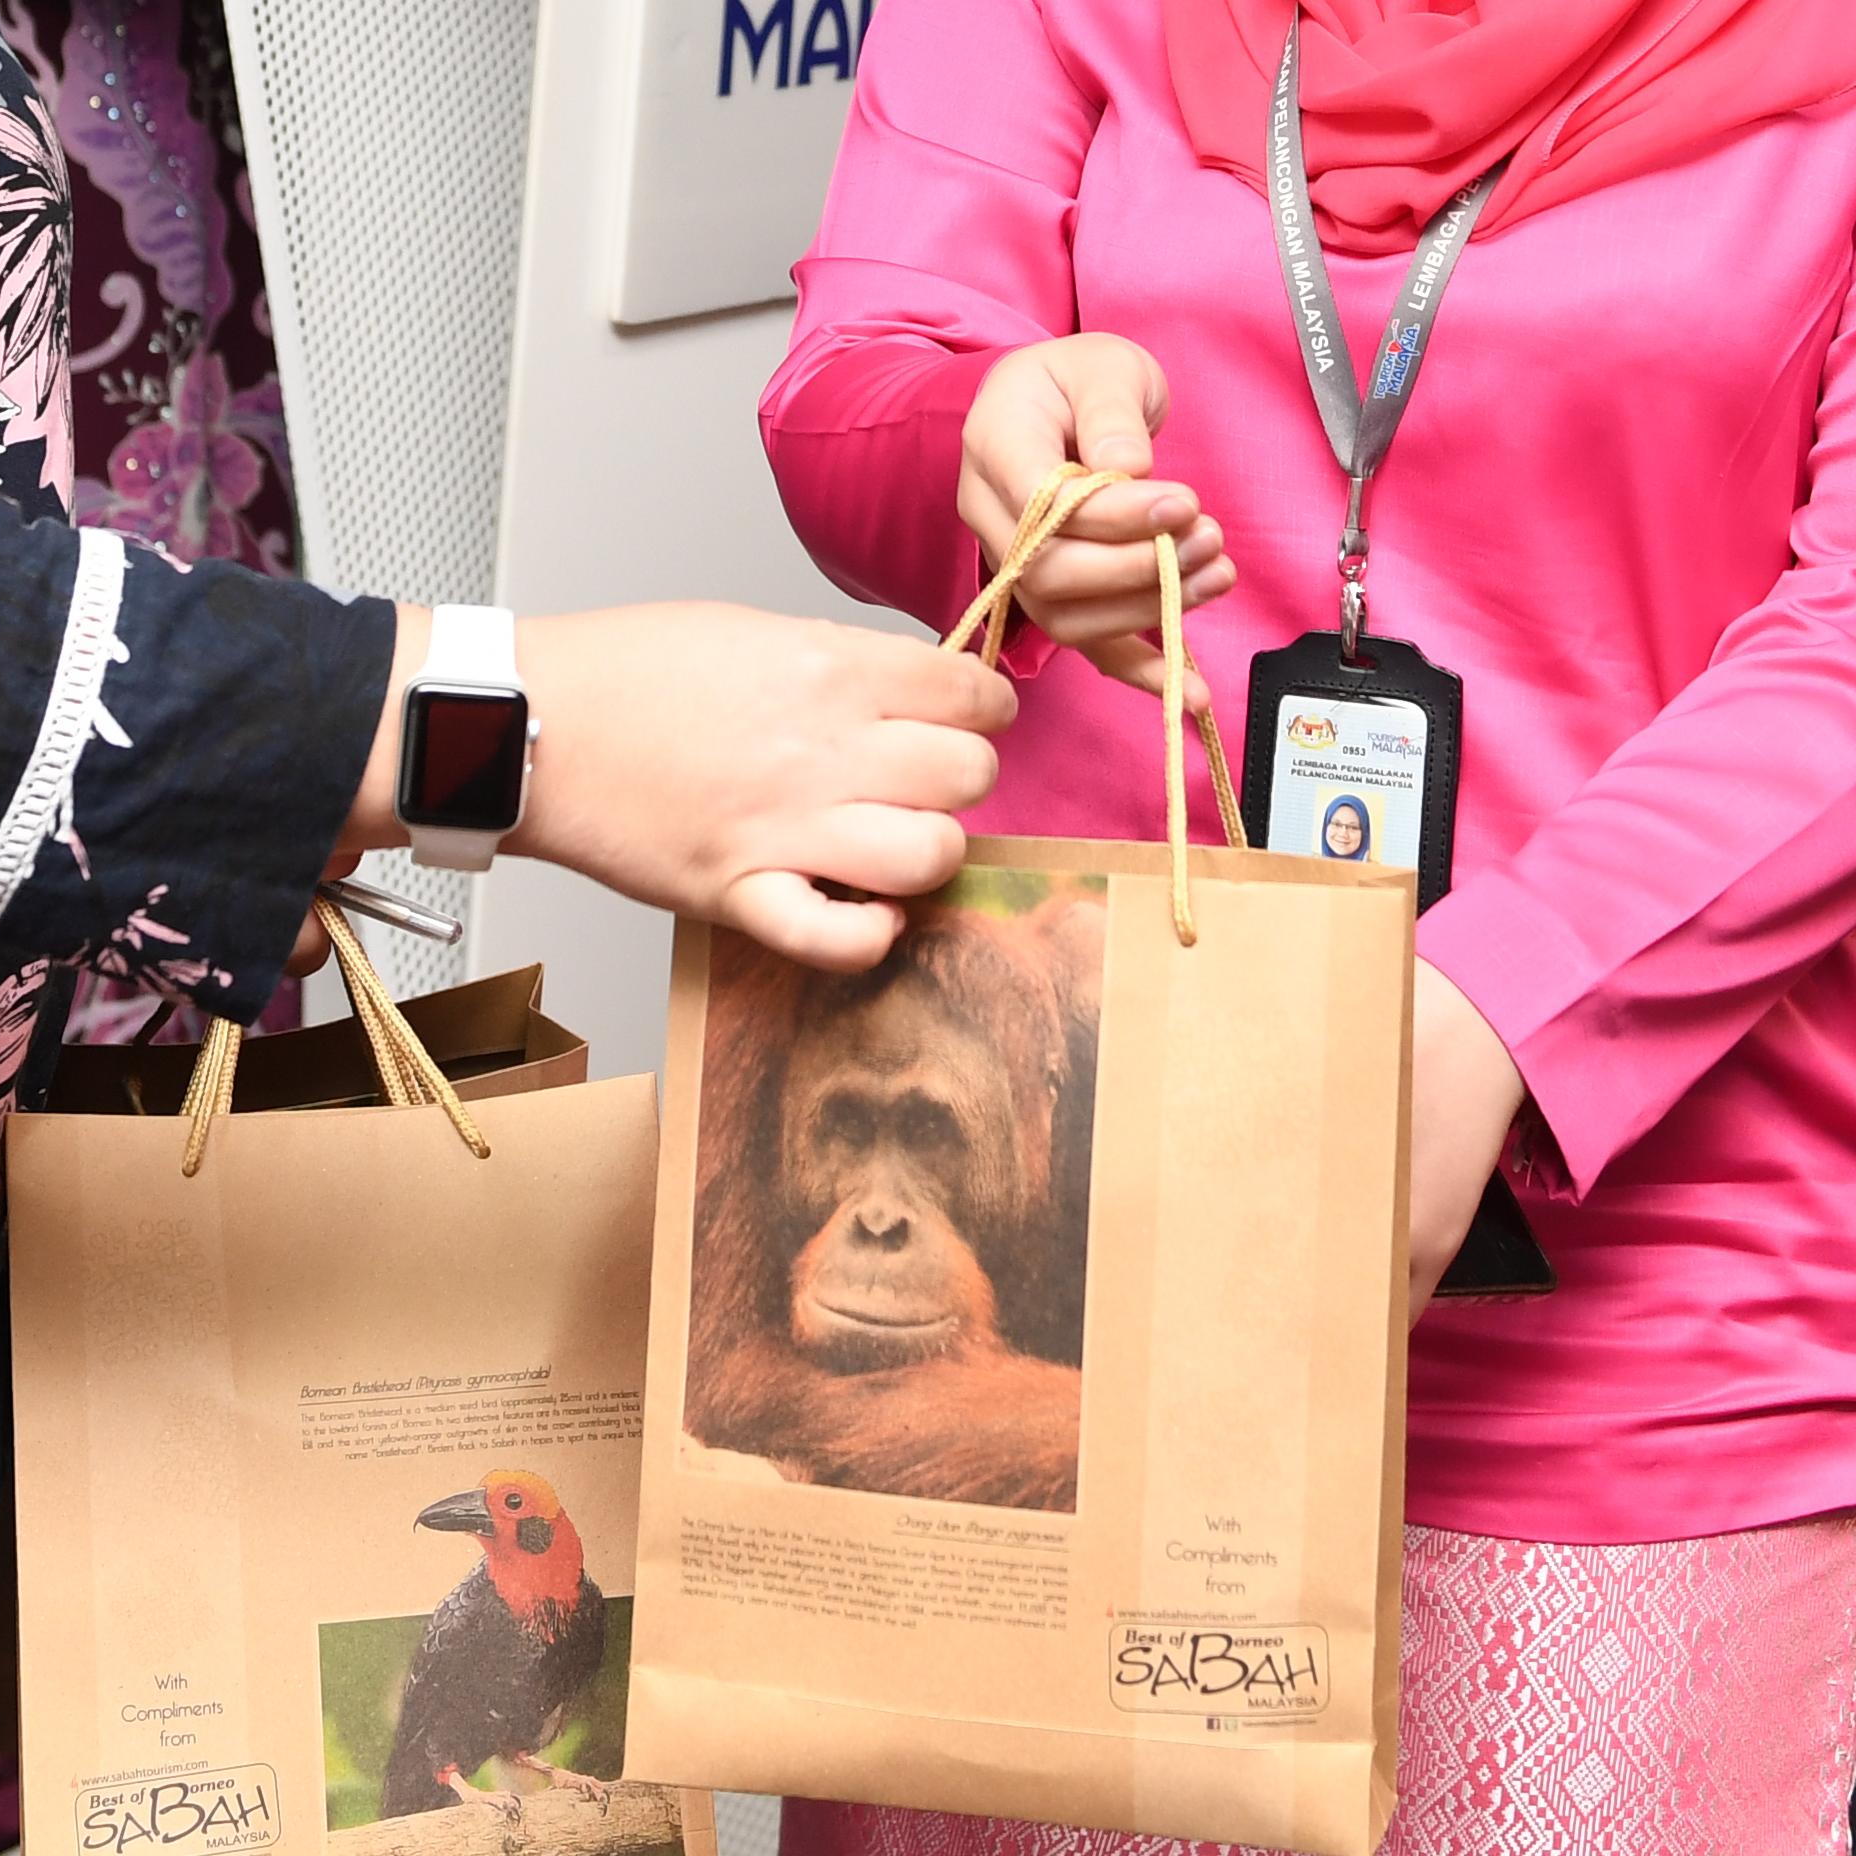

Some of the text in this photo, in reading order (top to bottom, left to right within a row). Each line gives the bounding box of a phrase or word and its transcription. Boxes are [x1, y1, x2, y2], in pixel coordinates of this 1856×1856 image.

[1274, 98, 1305, 257] PELANCONGAN
[1291, 260, 1335, 374] MALAYSIA
[1408, 209, 1467, 312] LEMBAGA
[1387, 328, 1420, 394] MALAYSIA
[1375, 352, 1395, 398] TOURISM
[1367, 732, 1400, 743] TOURISM
[1372, 741, 1423, 760] MALAYSIA
[1291, 768, 1413, 790] PELANCONGAN MALAYSIA
[1292, 758, 1413, 779] LEMBAGA PENGGALAKAN
[300, 1385, 346, 1399] Bornean
[352, 1378, 412, 1395] Bristlehead
[1205, 1514, 1242, 1534] With
[1165, 1540, 1278, 1568] Compliments
[1205, 1573, 1246, 1595] from
[1124, 1629, 1163, 1645] Best
[1169, 1631, 1186, 1649] of
[154, 1673, 188, 1690] With
[1247, 1695, 1318, 1709] MALAYSIA
[121, 1701, 224, 1725] Compliments
[160, 1730, 196, 1746] from
[81, 1760, 209, 1787] www.sabahtourism.com
[89, 1793, 124, 1809] Best
[130, 1788, 146, 1805] of
[206, 1830, 271, 1849] MALAYSIA
